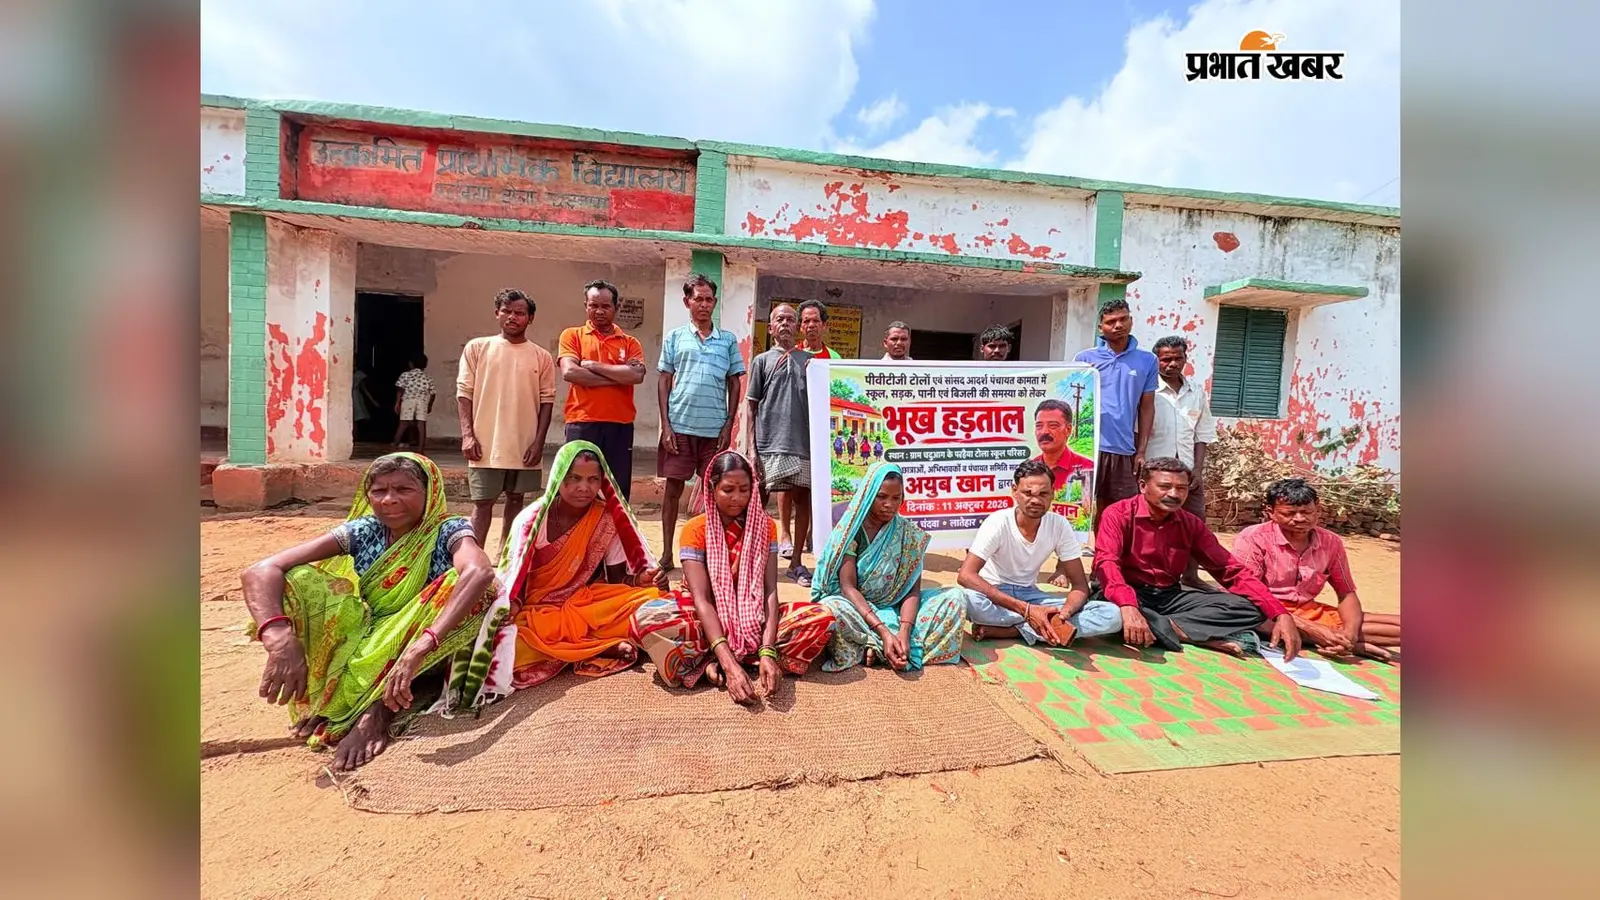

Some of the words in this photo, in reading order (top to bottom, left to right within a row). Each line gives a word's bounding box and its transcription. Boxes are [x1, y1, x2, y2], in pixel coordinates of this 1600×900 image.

[571, 151, 690, 194] विद्यालय
[865, 372, 907, 386] पीवीटीजी
[909, 372, 931, 386] टोलों
[932, 374, 943, 385] एवं
[944, 374, 965, 385] सांसद
[966, 373, 988, 386] आदर्श
[990, 374, 1015, 385] पंचायत
[1017, 376, 1040, 385] कामता
[865, 389, 888, 401] स्कूल,
[890, 389, 915, 401] सड़क,
[918, 386, 936, 399] पानी
[938, 388, 949, 399] एवं
[951, 386, 977, 399] बिजली
[979, 386, 990, 399] की
[991, 389, 1016, 399] समस्या
[1018, 387, 1028, 399] को
[1029, 387, 1047, 399] लेकर
[882, 405, 937, 445] भूख
[941, 405, 1025, 439] हड़ताल
[888, 452, 904, 460] स्थान
[909, 451, 922, 460] ग्राम
[946, 449, 954, 458] के
[974, 448, 989, 458] टोला
[990, 449, 1006, 460] स्कूल
[1007, 447, 1026, 457] परिसर
[968, 463, 989, 472] पंचायत
[990, 461, 1008, 472] समिति
[905, 474, 952, 497] अयुब
[956, 474, 995, 493] खान
[906, 501, 935, 513] दिनांक
[942, 502, 952, 511] 11
[954, 500, 985, 513] अक्टूबर
[986, 499, 1008, 509] 2026
[1052, 503, 1081, 518] खान
[949, 516, 977, 527] लातेहार
